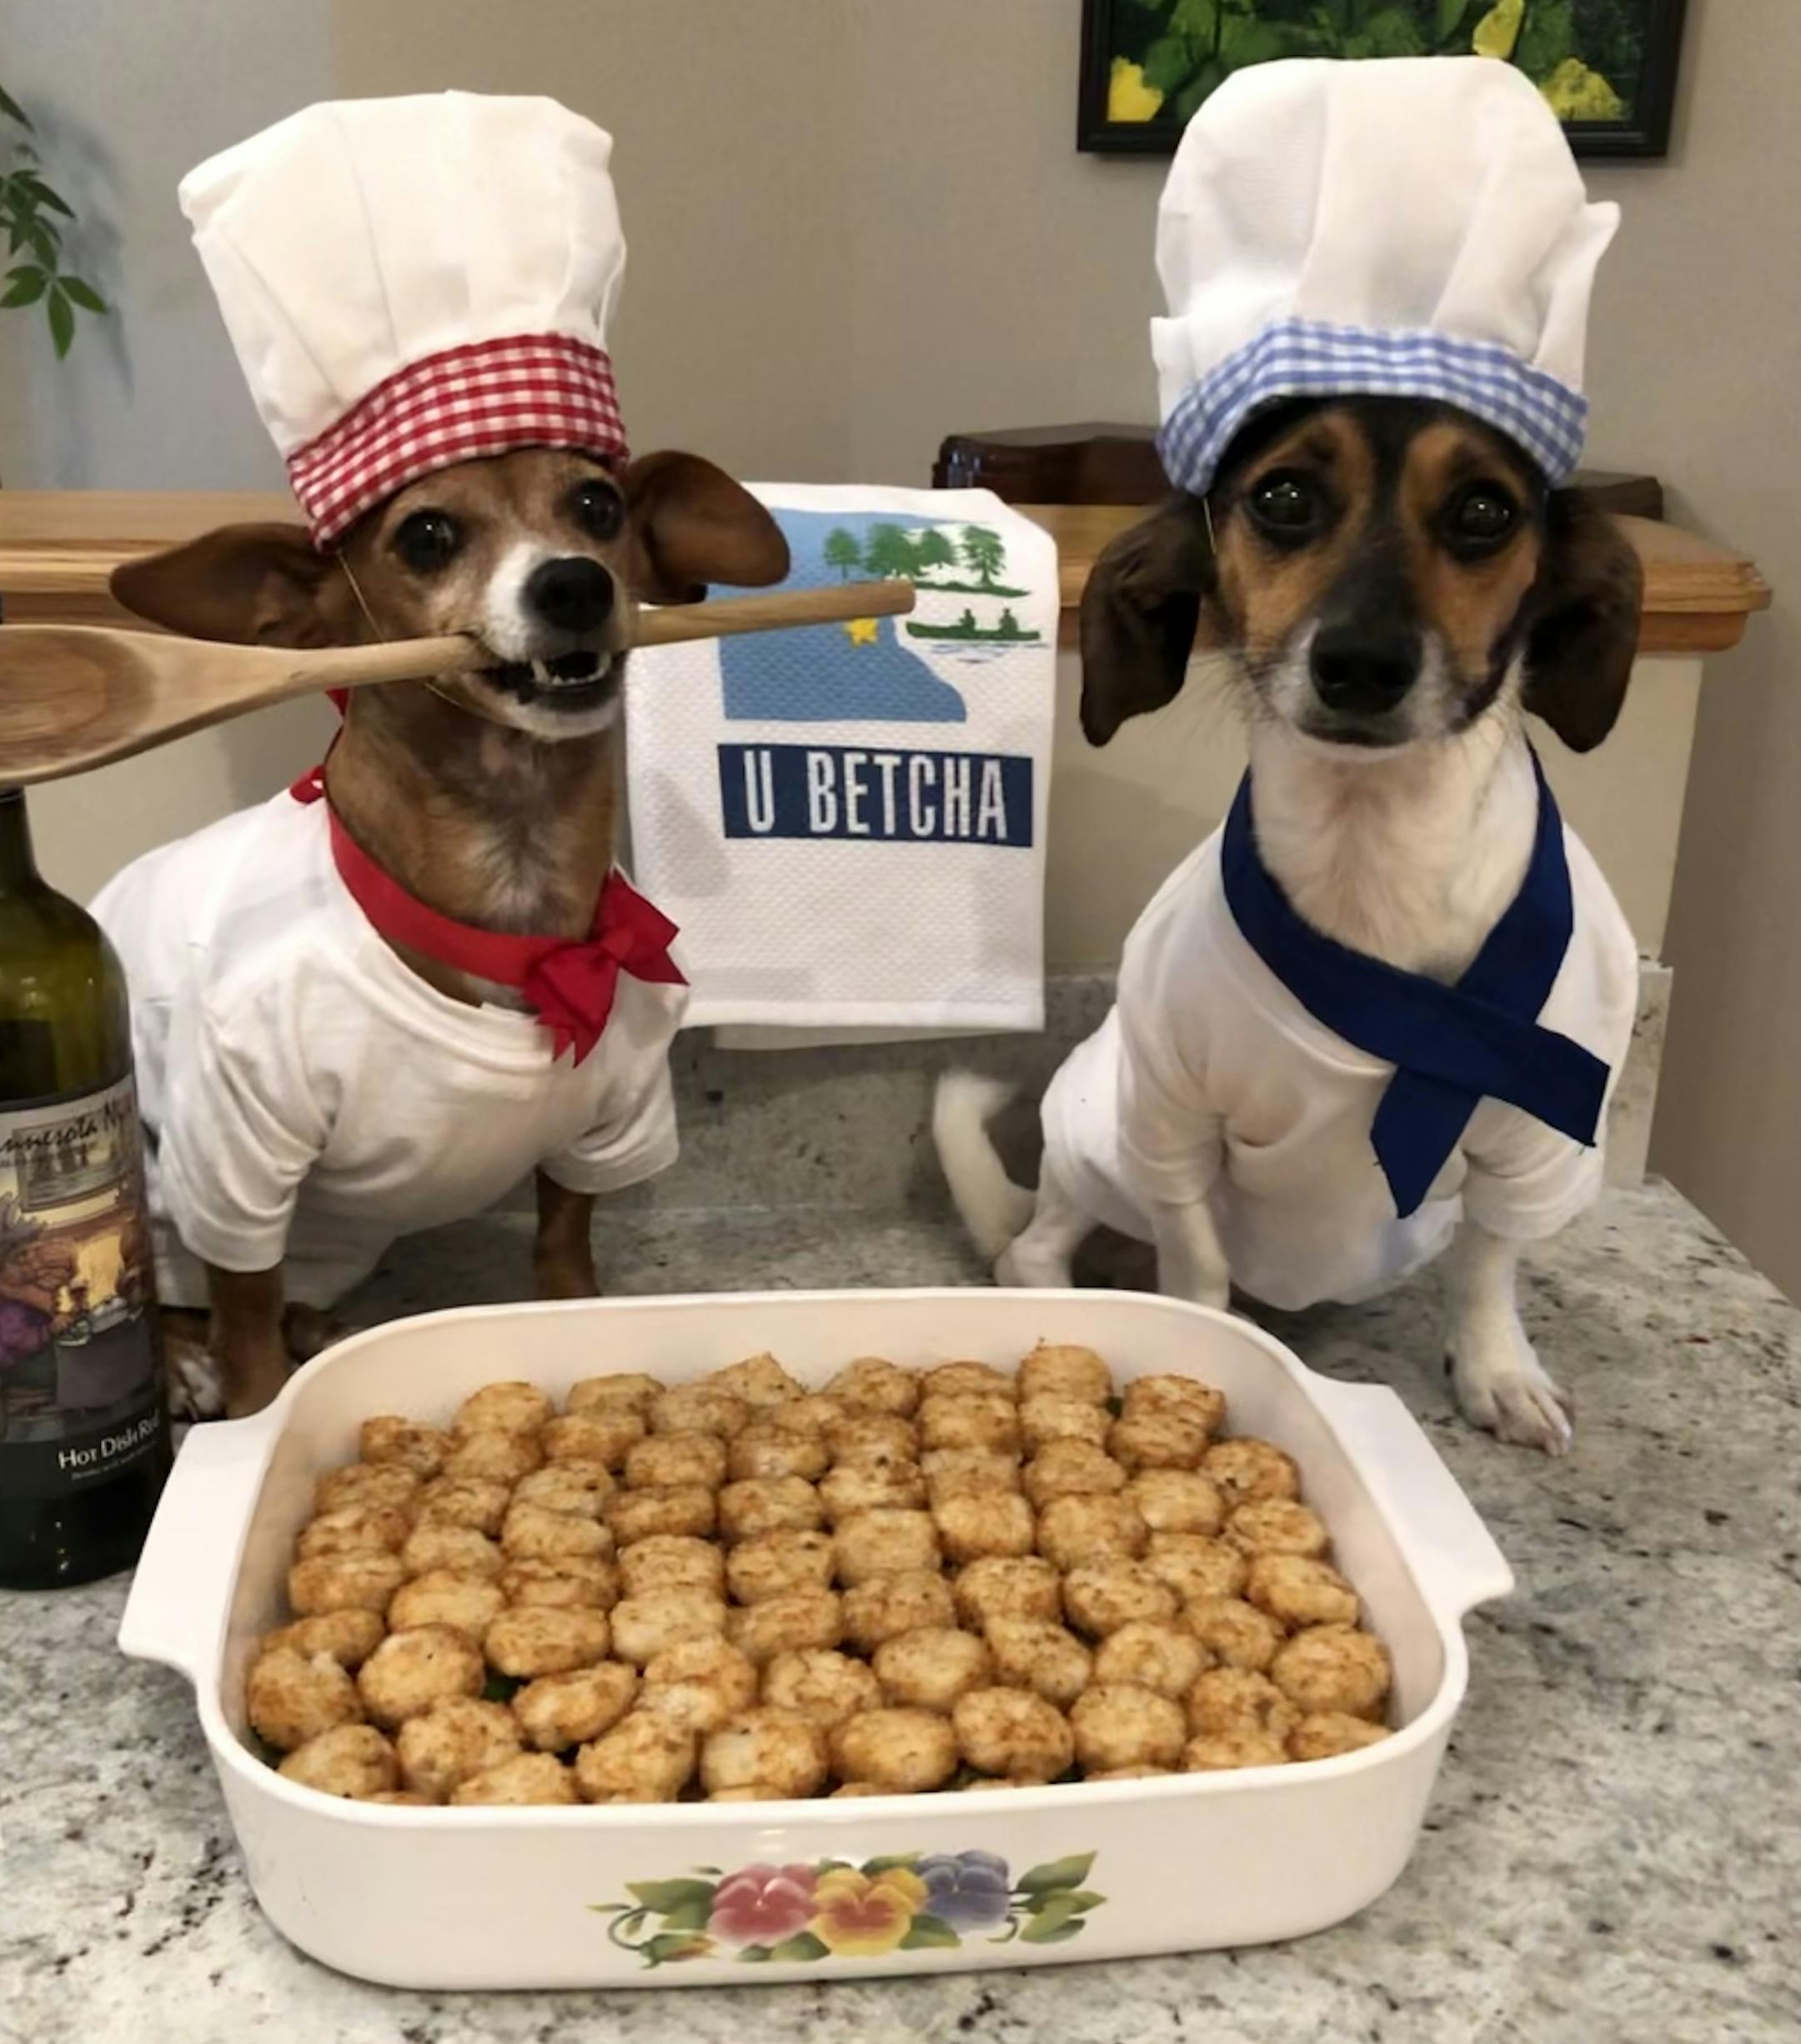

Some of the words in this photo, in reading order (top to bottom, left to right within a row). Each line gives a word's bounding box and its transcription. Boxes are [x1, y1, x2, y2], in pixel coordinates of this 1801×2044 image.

[743, 749, 775, 833] U
[806, 751, 1008, 839] BETCHA
[0, 1115, 98, 1151] nnesota
[58, 1448, 98, 1470] Hot
[100, 1427, 138, 1458] Dish
